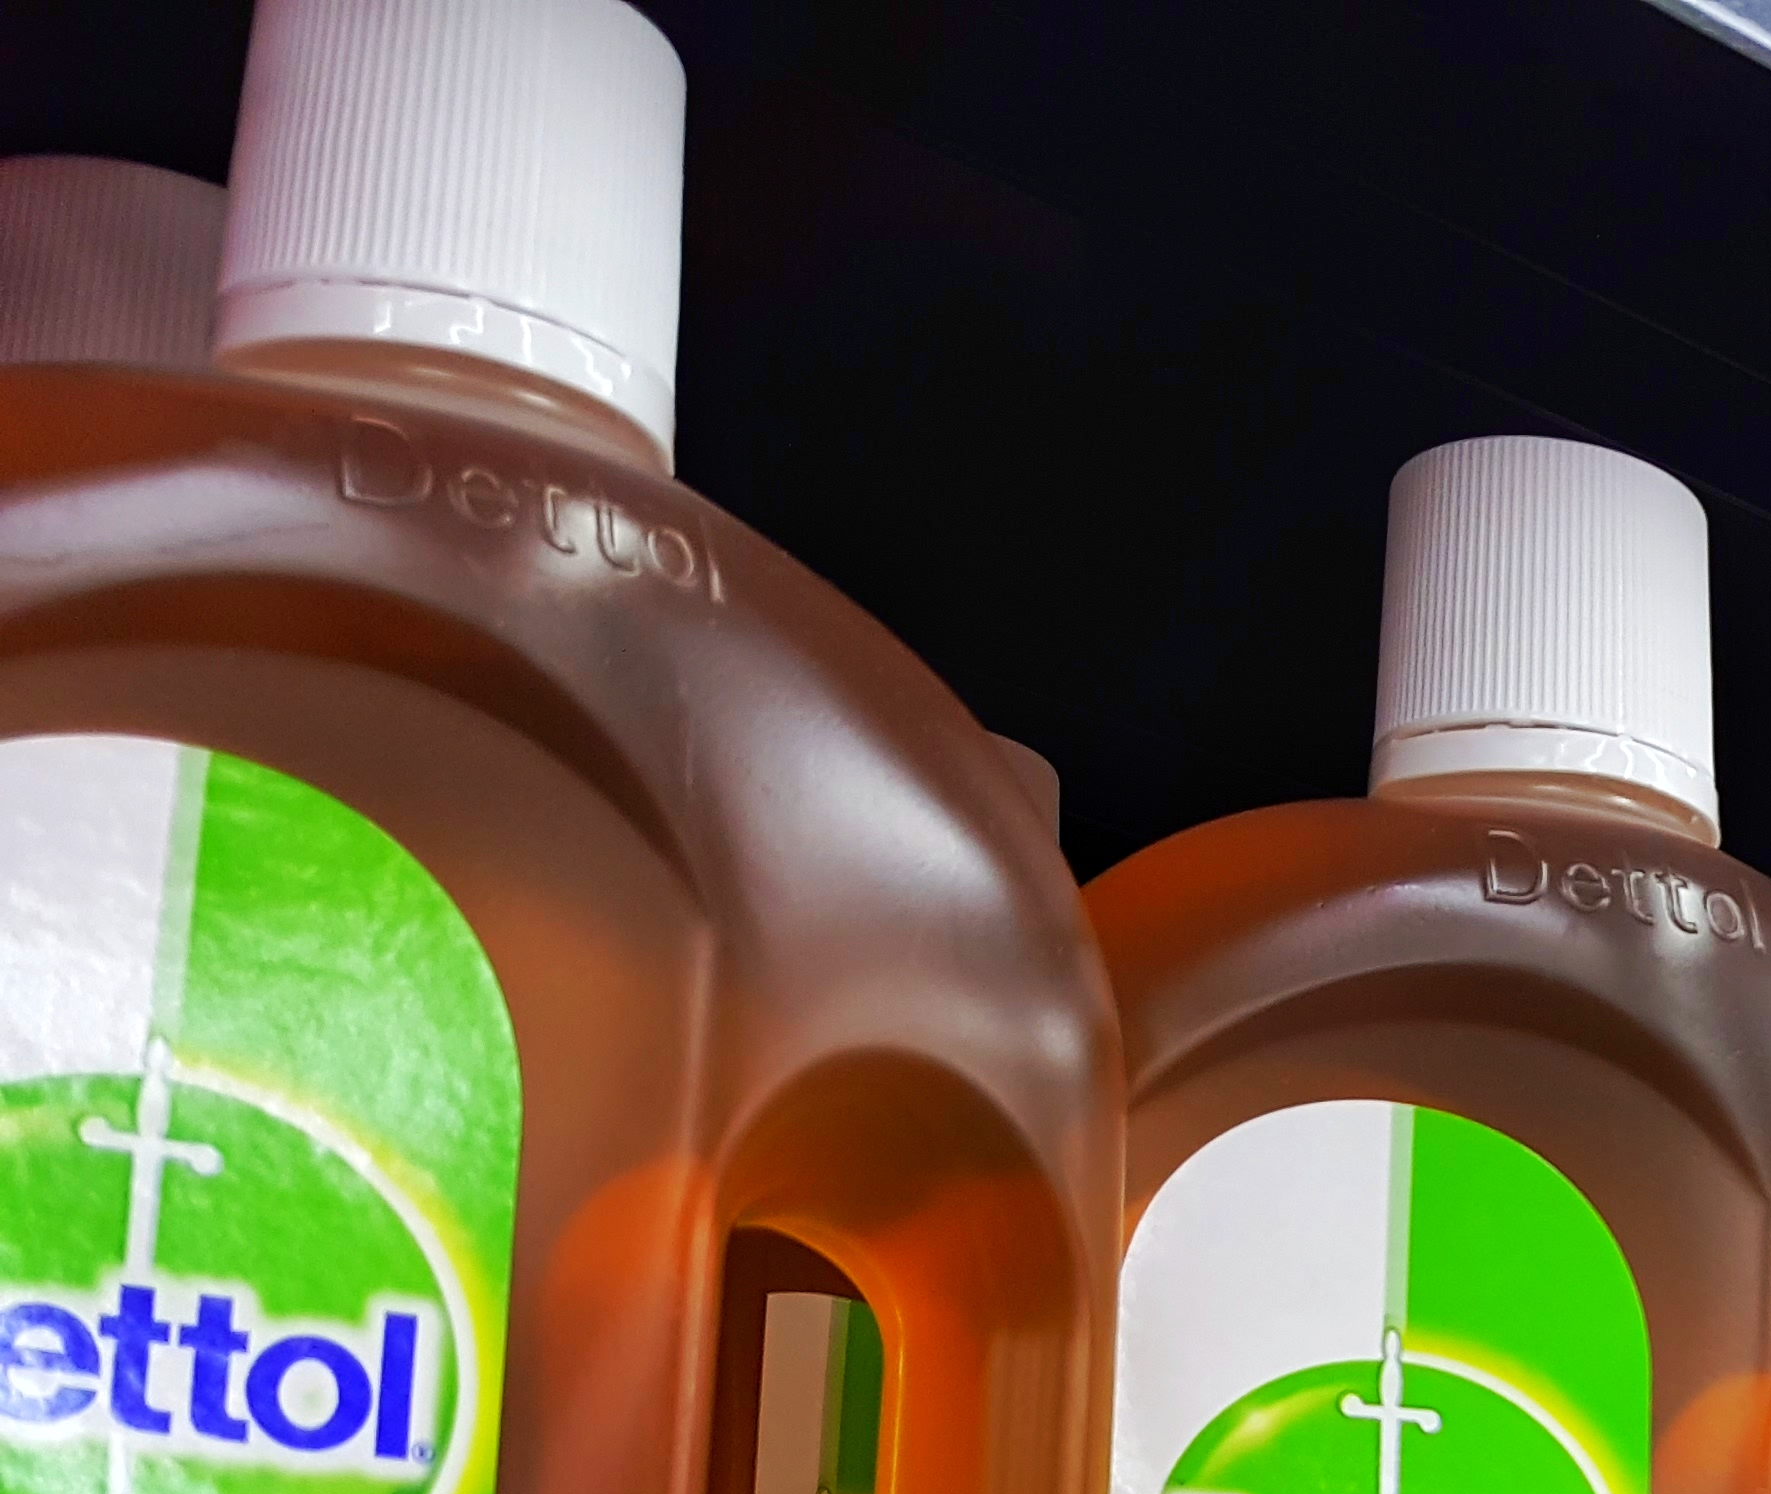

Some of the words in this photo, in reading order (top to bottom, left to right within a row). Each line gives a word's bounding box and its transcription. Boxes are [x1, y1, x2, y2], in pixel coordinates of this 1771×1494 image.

[338, 411, 730, 605] Dettol
[1481, 828, 1768, 955] Dettol
[0, 1283, 419, 1460] ettol
